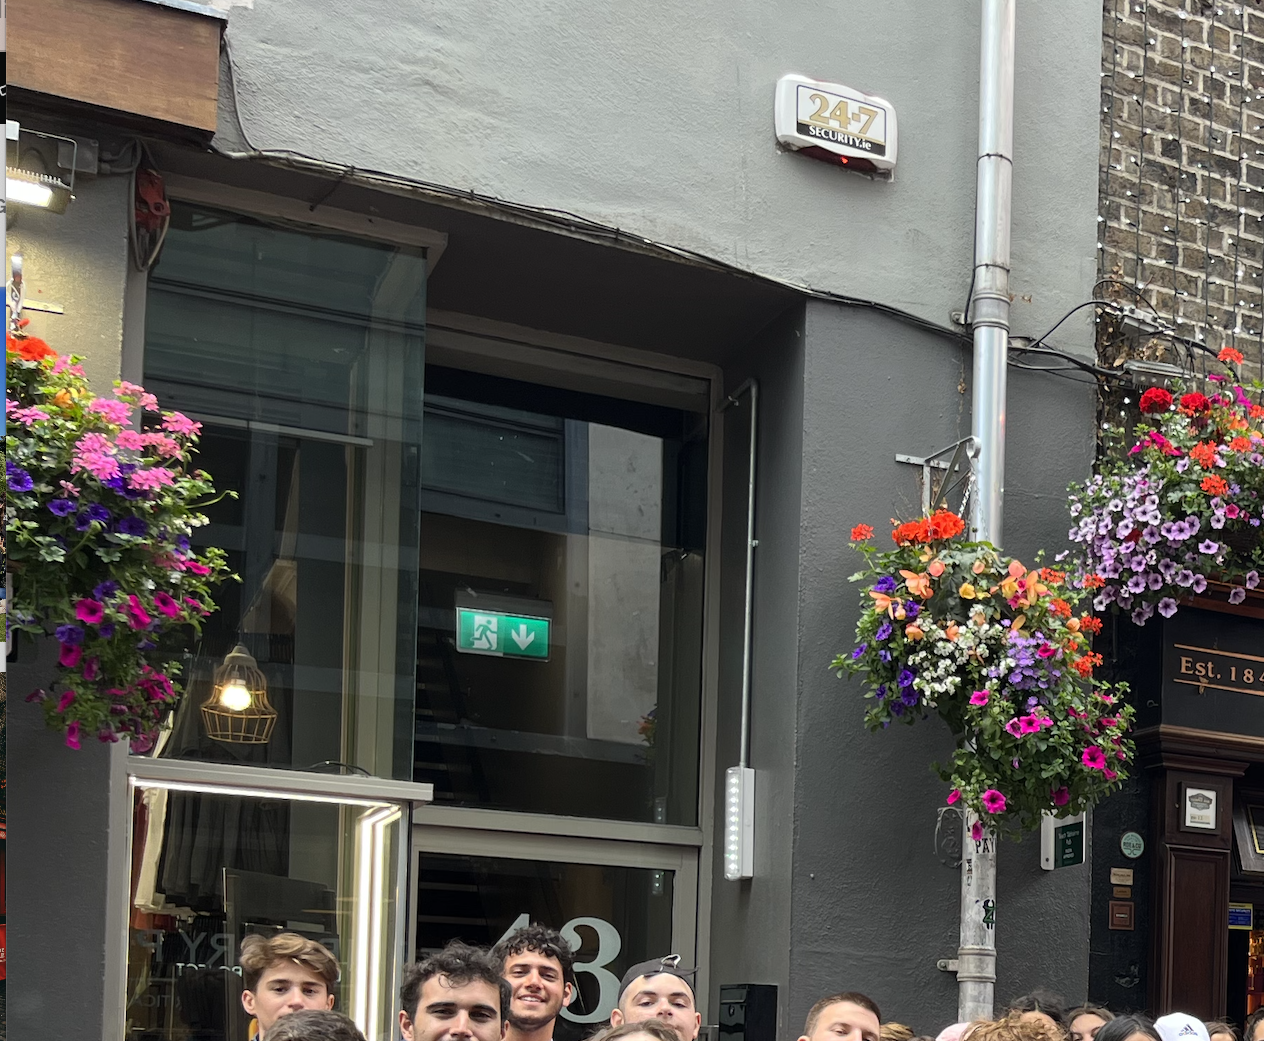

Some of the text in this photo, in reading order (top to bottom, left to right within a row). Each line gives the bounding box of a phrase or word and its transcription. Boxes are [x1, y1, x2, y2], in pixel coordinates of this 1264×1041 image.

[809, 93, 878, 135] 24-7
[808, 125, 872, 150] SECURITY.ie
[1180, 656, 1222, 681] Est.
